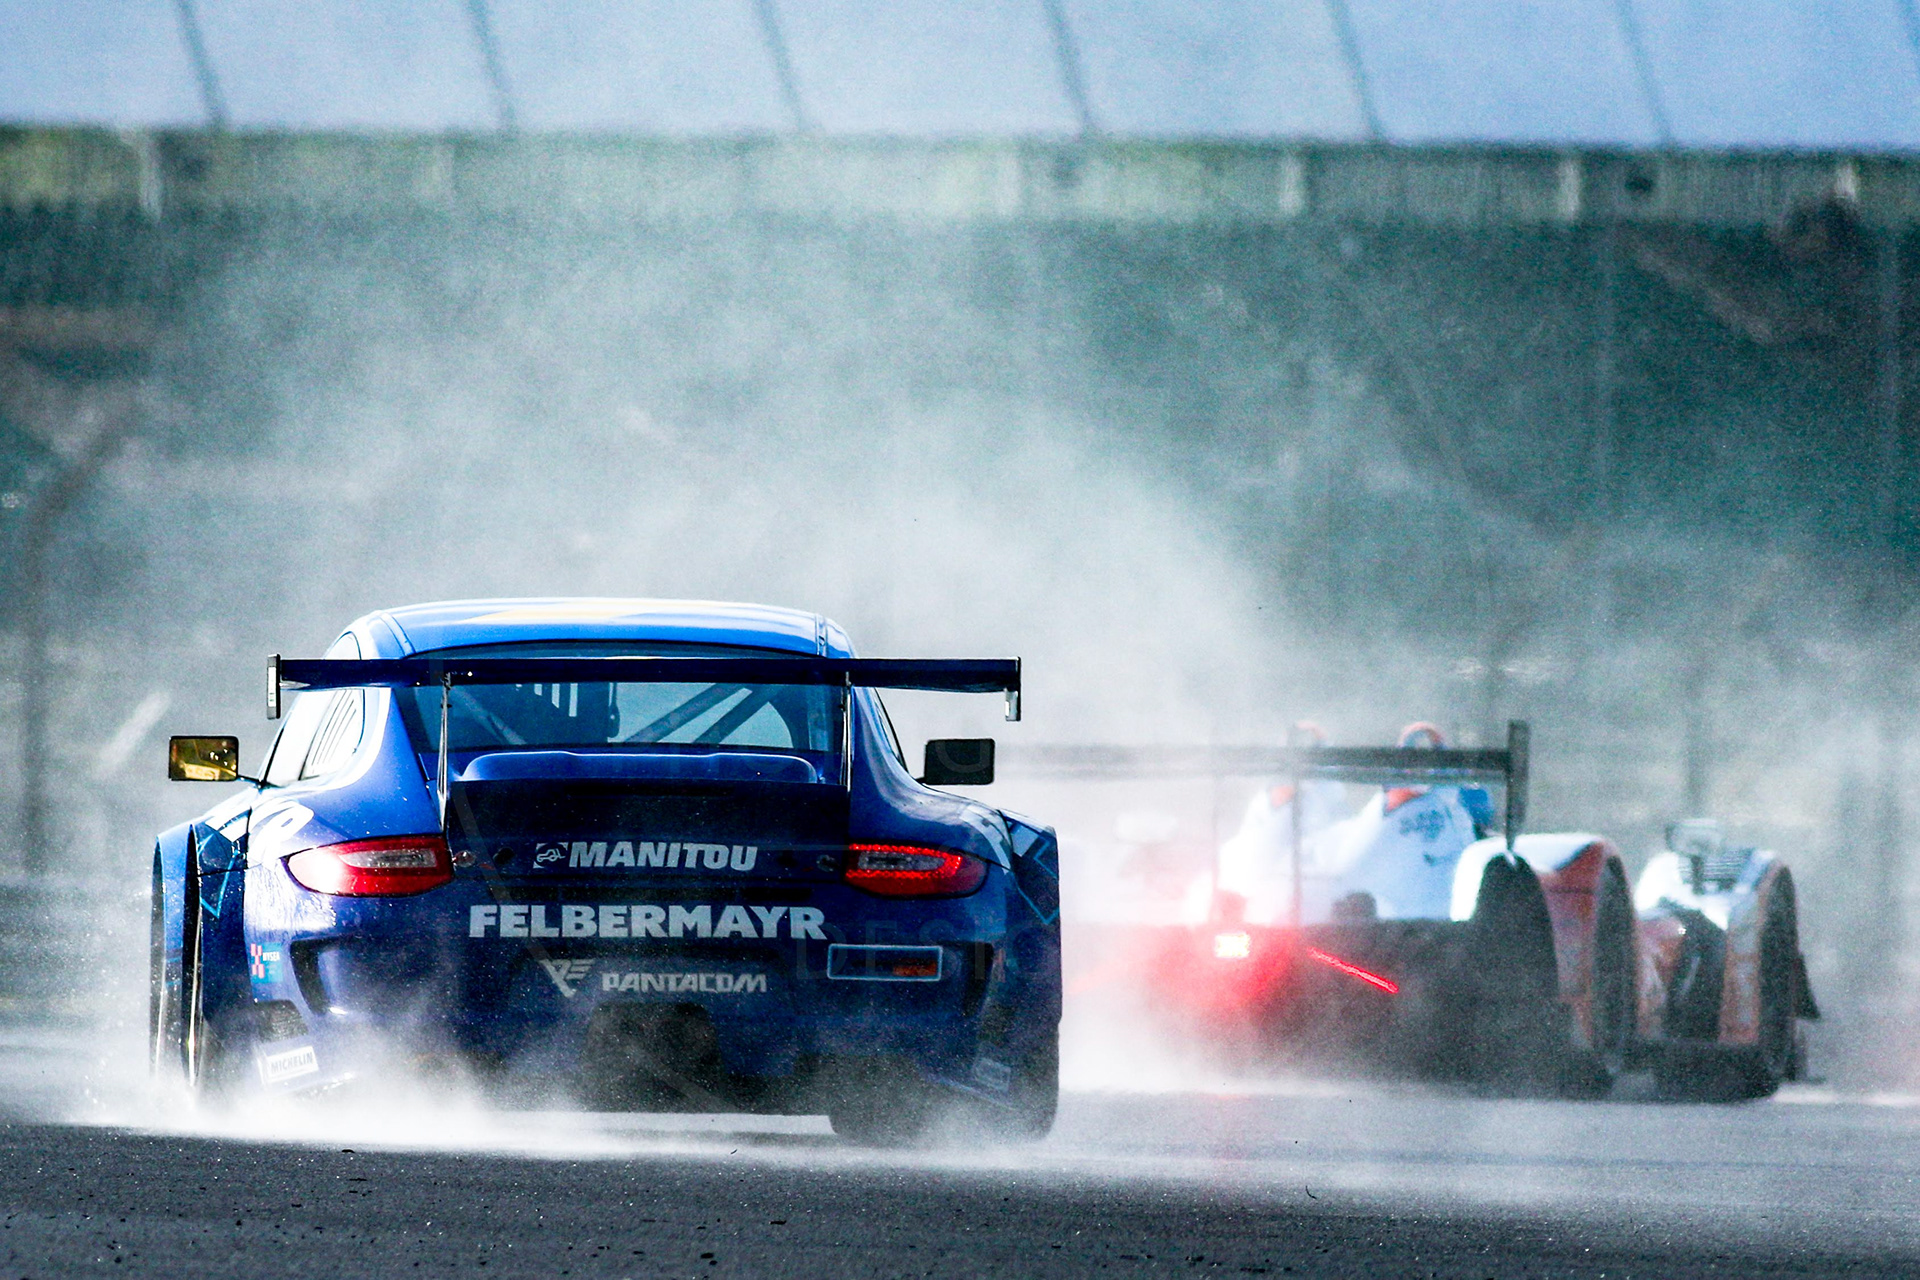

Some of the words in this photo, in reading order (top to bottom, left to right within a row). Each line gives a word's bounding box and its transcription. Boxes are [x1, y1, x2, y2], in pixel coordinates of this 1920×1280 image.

[569, 841, 758, 871] MANITOU
[469, 904, 828, 940] FELBERMAYR
[602, 971, 768, 993] PANTACOM
[270, 1051, 314, 1075] MICHELIN
